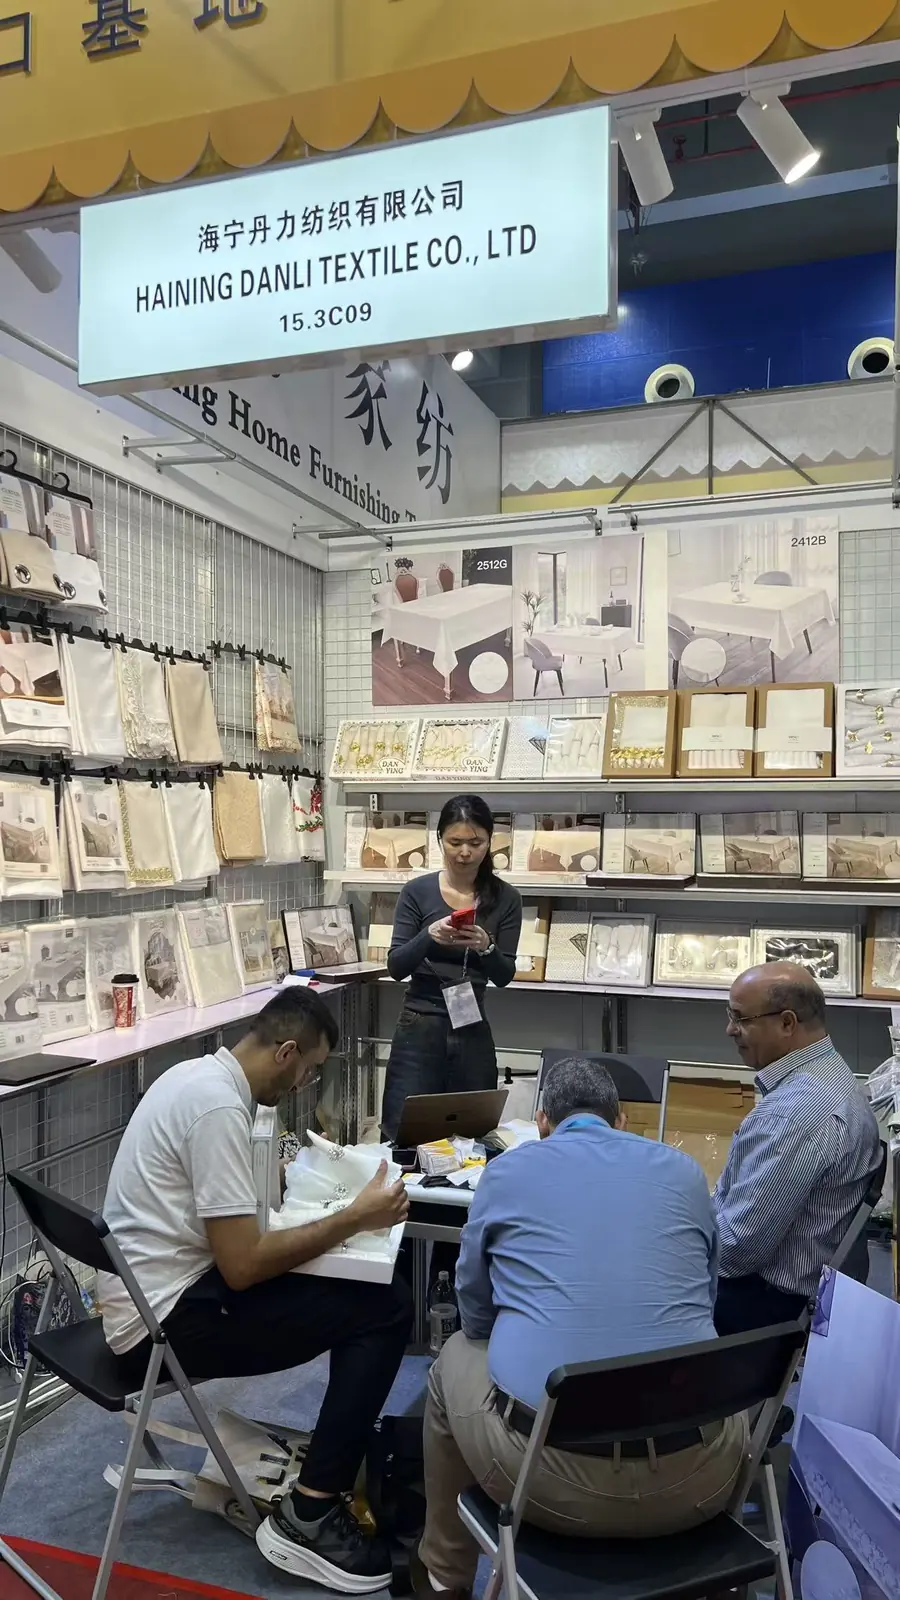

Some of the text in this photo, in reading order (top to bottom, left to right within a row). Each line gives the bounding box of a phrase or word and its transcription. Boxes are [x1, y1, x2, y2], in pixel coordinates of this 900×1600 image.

[198, 181, 464, 253] 海宁丹力纺织有限公司
[136, 224, 537, 313] HAINING DANLI TEXTILE CO., LTD
[279, 302, 372, 333] 15.3C09
[228, 389, 300, 468] Home
[476, 559, 508, 571] 2512G
[791, 535, 827, 548] 2412B
